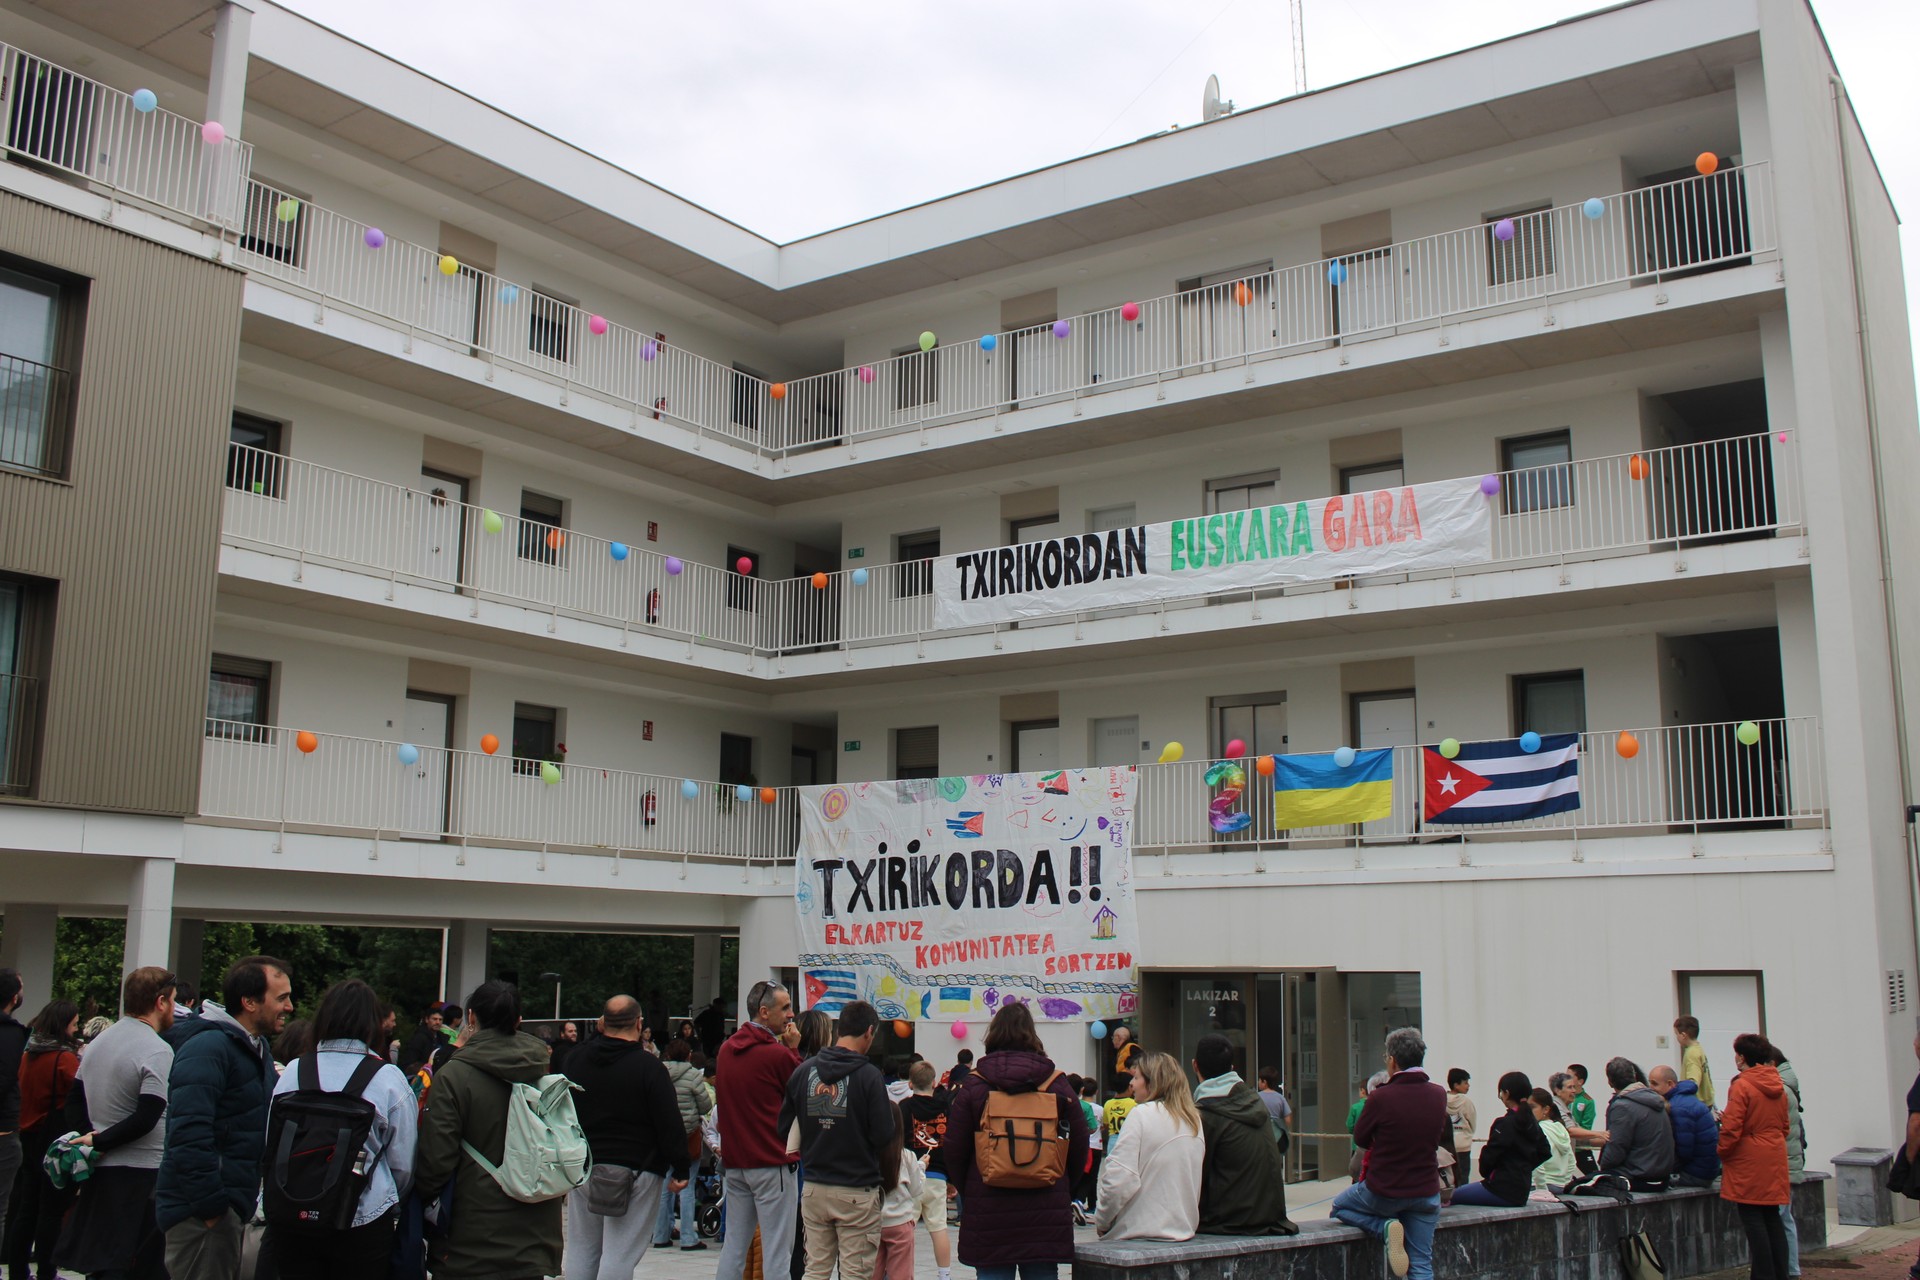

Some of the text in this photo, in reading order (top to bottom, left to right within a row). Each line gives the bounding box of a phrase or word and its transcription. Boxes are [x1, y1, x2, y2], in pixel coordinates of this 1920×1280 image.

[956, 487, 1423, 601] TXIRIKORDAN EUSKARA GARA
[825, 921, 923, 945] ELKARTUZ
[915, 934, 1055, 969] KOMUNITATEA
[1044, 952, 1132, 976] SORTZEN
[1186, 990, 1240, 1001] LAKIZAR
[1209, 1006, 1216, 1017] 2
